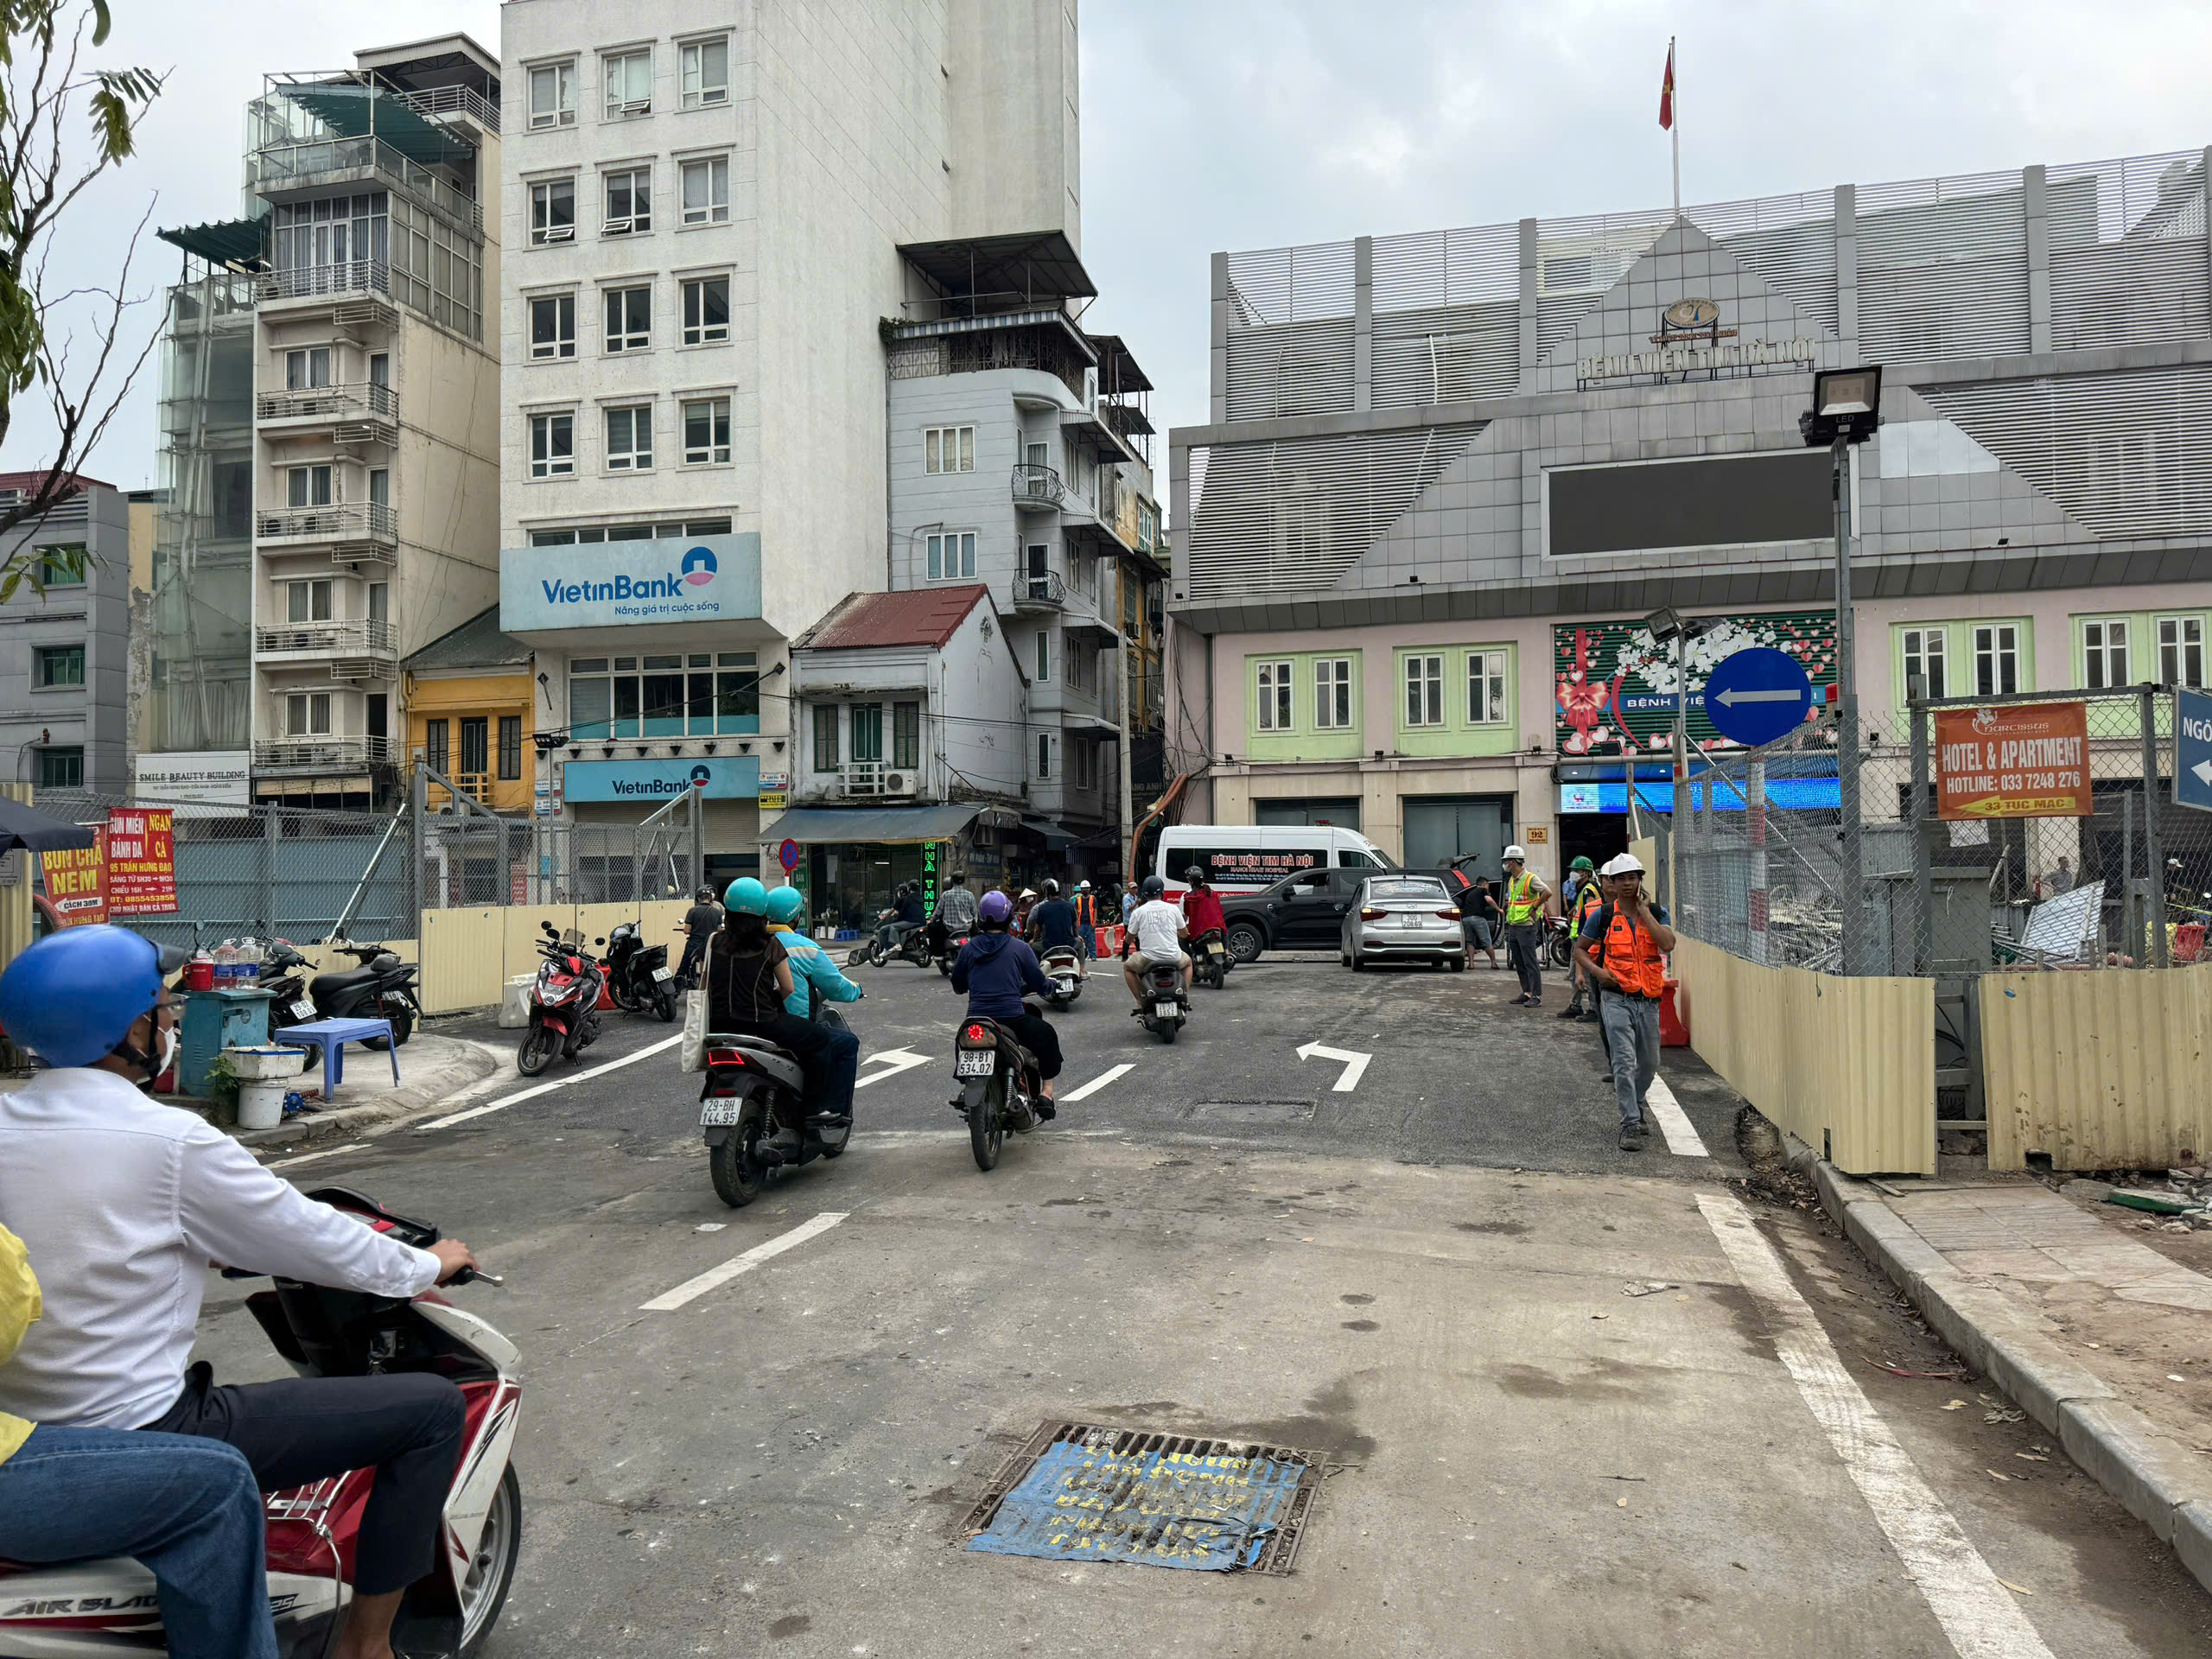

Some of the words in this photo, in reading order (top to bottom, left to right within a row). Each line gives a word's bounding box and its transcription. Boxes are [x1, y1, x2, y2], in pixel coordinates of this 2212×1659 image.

[542, 572, 683, 604] VietinBank
[614, 606, 639, 616] Nâng
[642, 604, 657, 616] giá
[660, 603, 670, 614] trị
[671, 602, 694, 614] cuộc
[696, 600, 720, 612] sống
[1627, 697, 1671, 709] BỆNH
[2183, 716, 2212, 742] NGÕ
[1942, 741, 1983, 772] HOTEL
[1986, 741, 1997, 770] &
[2000, 736, 2082, 769] APARTMENT
[169, 772, 205, 781] BEAUTY
[207, 771, 245, 779] BUILDING
[1947, 775, 1998, 793] HOTLINE:
[2001, 773, 2023, 791] 033
[2025, 772, 2054, 789] 7248
[2058, 771, 2081, 788] 276
[612, 779, 691, 794] VietinBank
[1985, 802, 2001, 811] 33
[2005, 800, 2030, 810] TUC
[2034, 798, 2064, 809] MAC
[149, 814, 171, 831] NGAN
[111, 837, 131, 858] BÁNH
[925, 842, 936, 871] NHÀ
[1211, 854, 1236, 868] BỆNH
[1238, 854, 1260, 868] VIỆN
[1262, 855, 1279, 866] TIM
[1281, 854, 1294, 866] HÀ
[1296, 854, 1313, 868] NỘI
[110, 863, 118, 872] 95
[52, 869, 97, 895] NEM
[963, 1052, 988, 1063] 98-B1
[960, 1063, 991, 1074] 534.02
[707, 1100, 735, 1112] 29-BH
[702, 1112, 735, 1123] 144.95
[3, 1599, 74, 1616] AIR
[78, 1595, 158, 1611] BLAD
